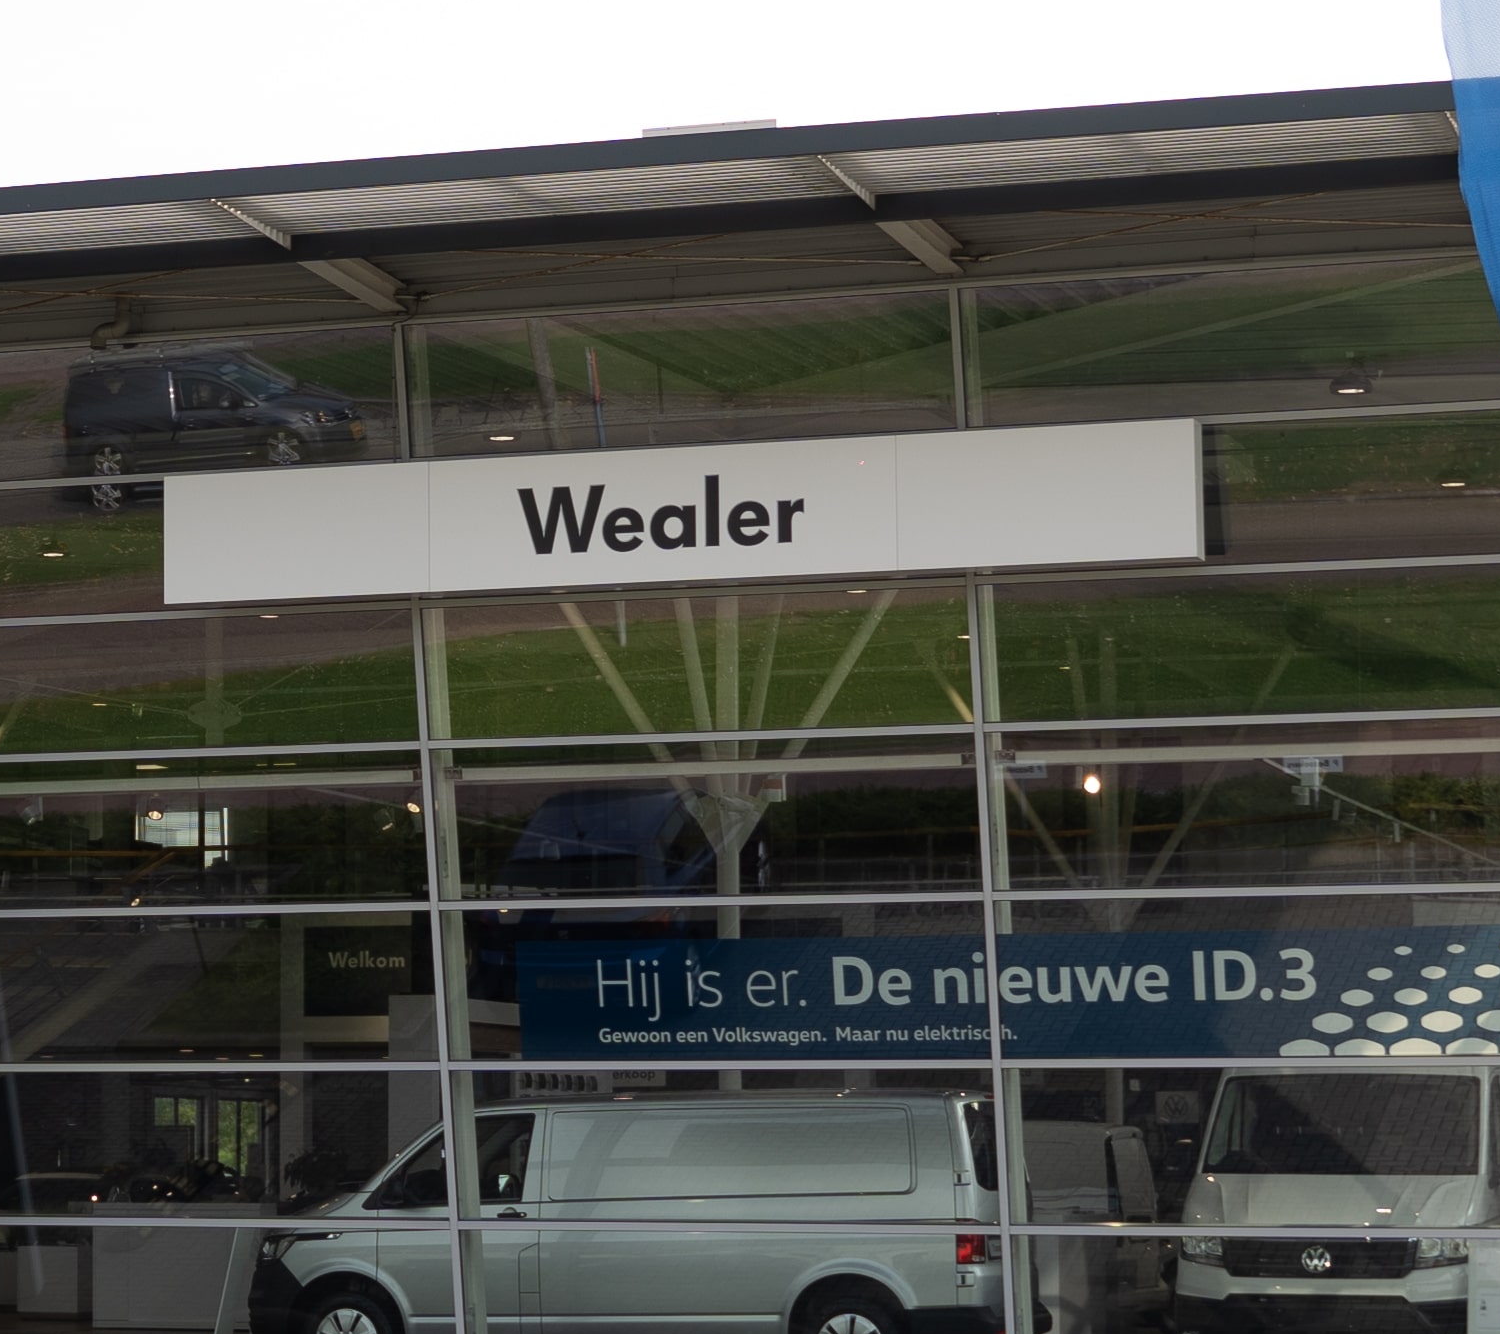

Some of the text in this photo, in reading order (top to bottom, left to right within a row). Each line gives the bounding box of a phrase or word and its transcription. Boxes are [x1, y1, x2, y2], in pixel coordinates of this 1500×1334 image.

[516, 474, 805, 555] Wealer
[328, 950, 406, 969] Welkom
[596, 947, 1317, 1022] Hij is er. De nieuwe ID.3
[598, 1024, 1019, 1047] Gewoon een Volkswagen. Maar nu elektrisch.
